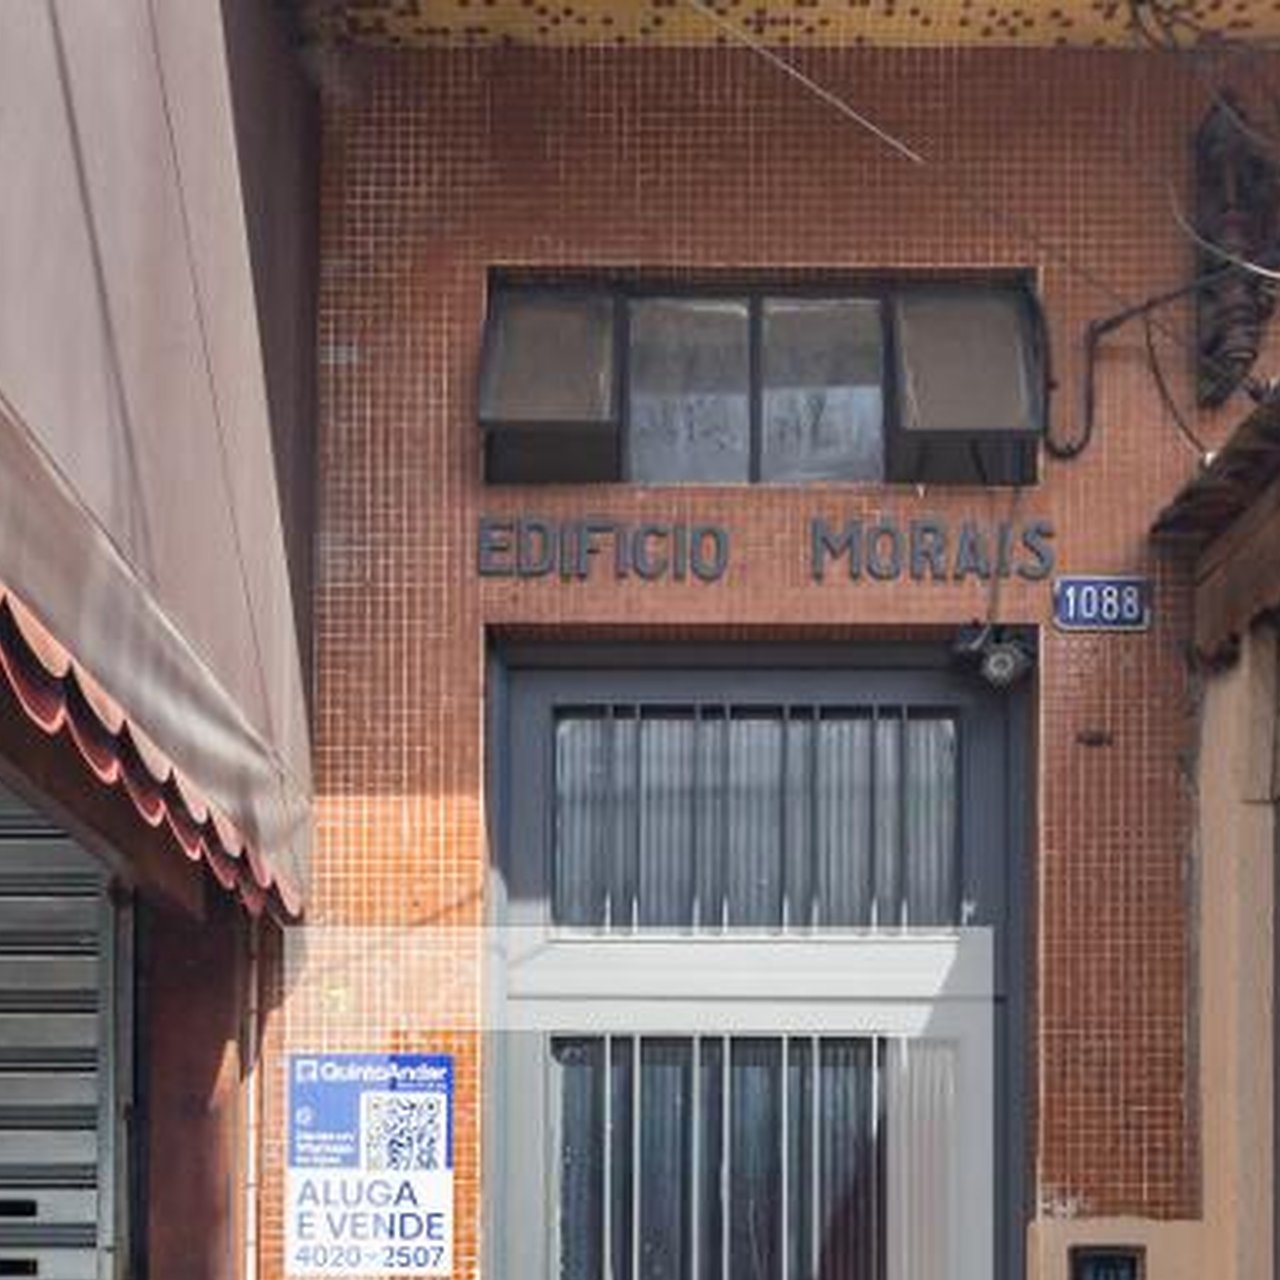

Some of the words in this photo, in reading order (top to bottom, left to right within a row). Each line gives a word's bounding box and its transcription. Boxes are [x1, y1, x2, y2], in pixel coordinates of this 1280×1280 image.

[477, 519, 729, 582] EDIFICIO
[809, 516, 1056, 582] MORAIS
[1065, 585, 1139, 620] 1088
[297, 1178, 418, 1206] ALUGA
[298, 1212, 315, 1241] E
[326, 1212, 445, 1241] VENDE
[295, 1246, 445, 1268] 4020-2507
